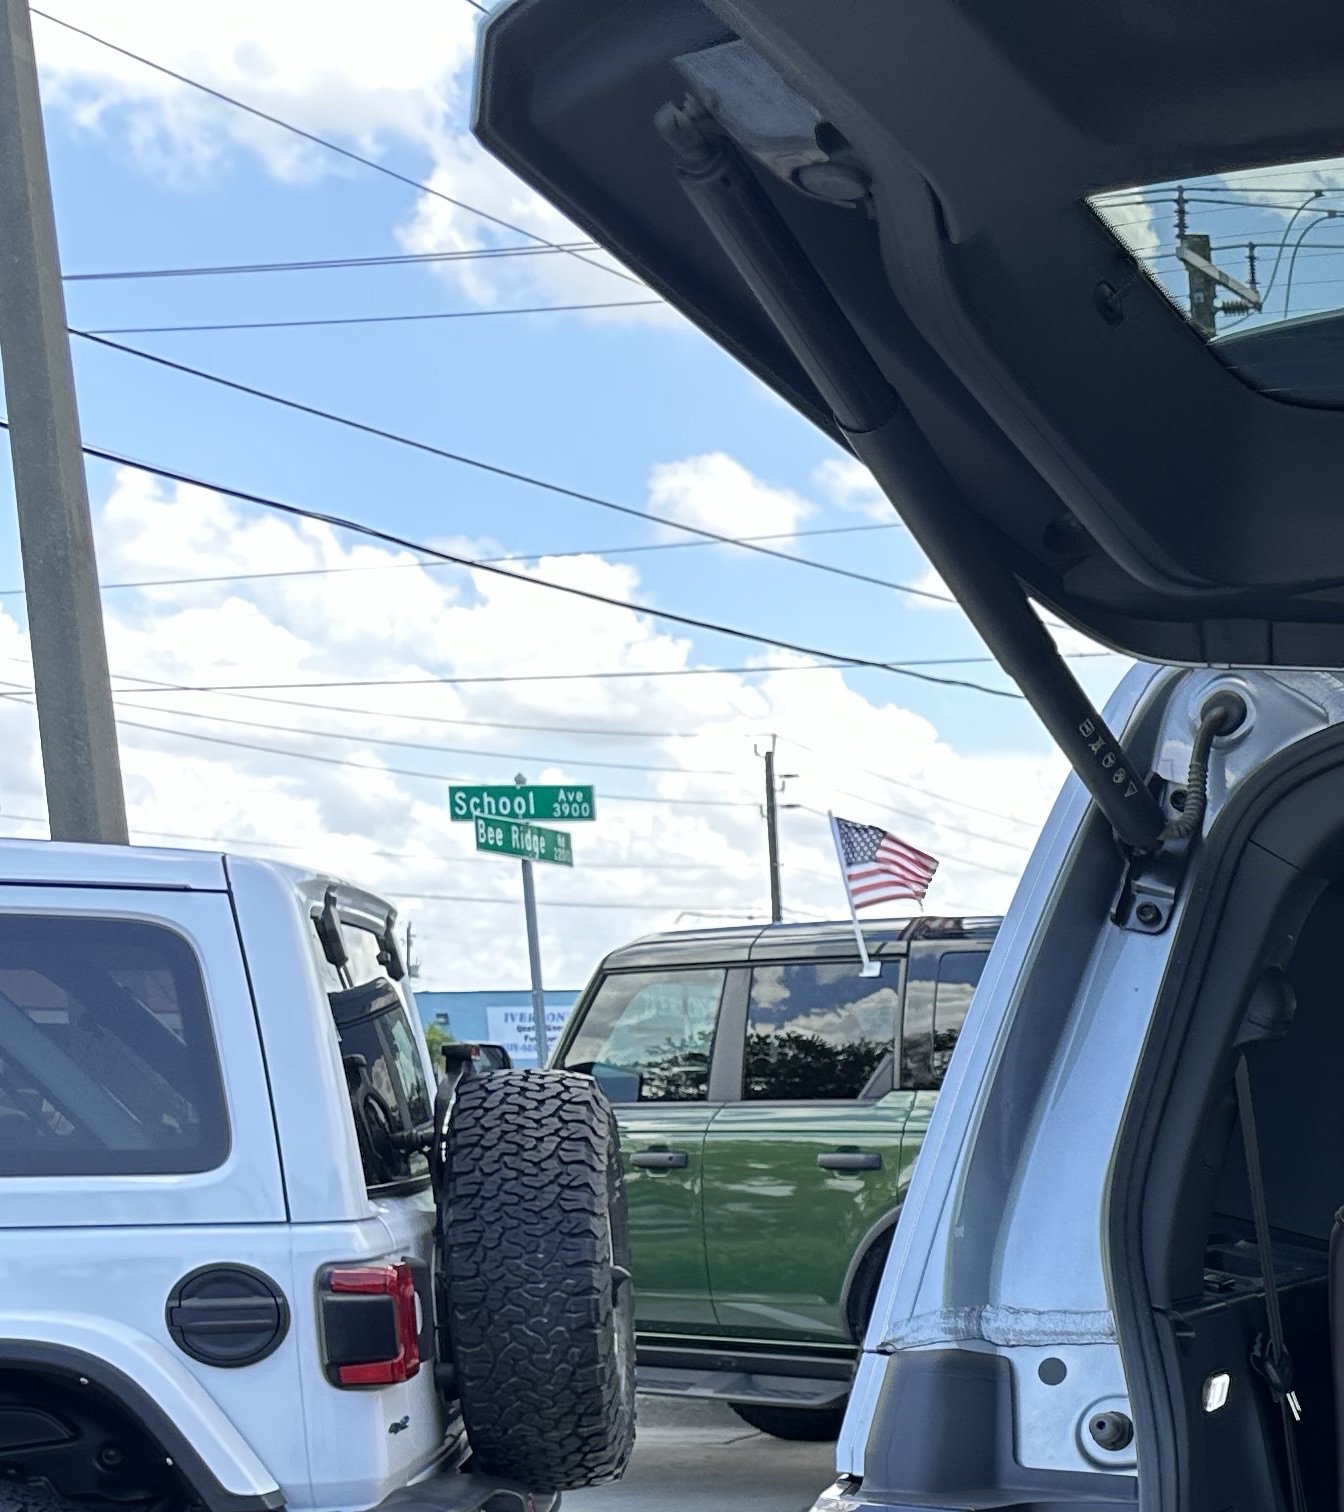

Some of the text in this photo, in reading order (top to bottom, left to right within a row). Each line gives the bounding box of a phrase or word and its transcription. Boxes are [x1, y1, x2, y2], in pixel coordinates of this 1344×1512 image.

[454, 788, 583, 815] School Ave
[552, 802, 590, 817] 3900
[477, 818, 503, 847] Bee
[511, 825, 546, 858] Ridge
